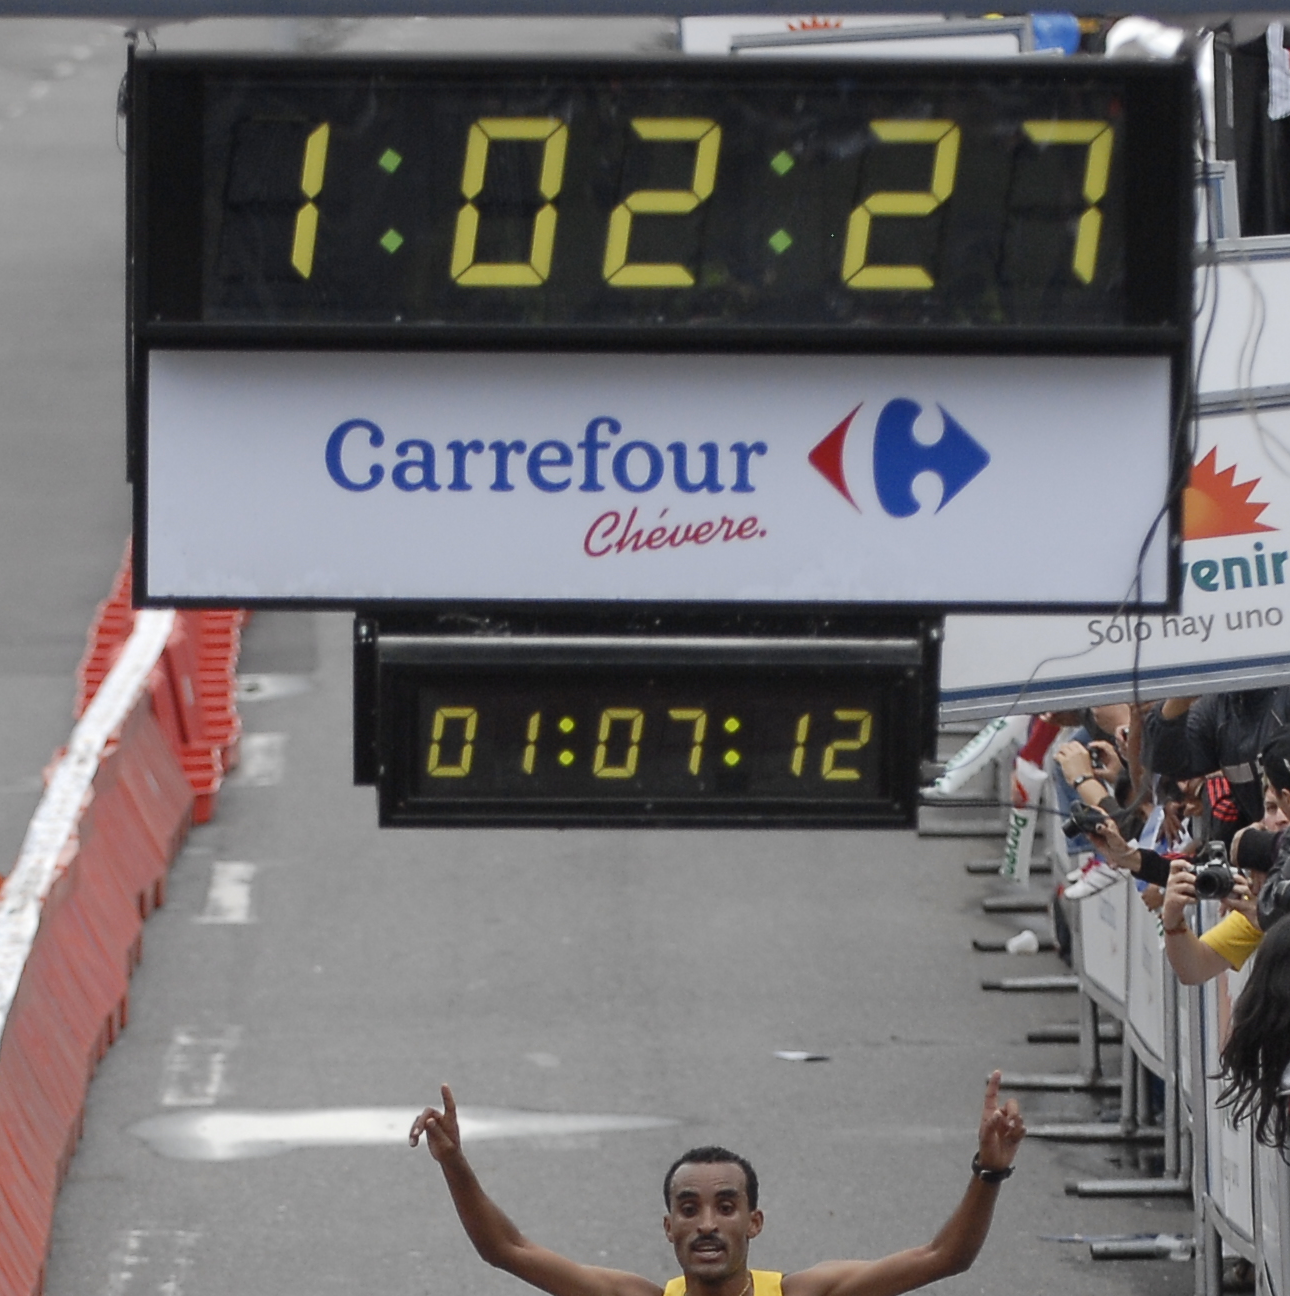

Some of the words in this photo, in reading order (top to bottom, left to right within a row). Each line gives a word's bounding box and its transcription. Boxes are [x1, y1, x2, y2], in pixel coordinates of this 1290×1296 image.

[284, 105, 1121, 296] 1:02:27
[324, 415, 768, 494] Carrefour
[583, 506, 767, 558] Chévere.
[1161, 612, 1214, 643] hay
[1225, 606, 1283, 632] uno
[425, 705, 875, 782] 01:07:12
